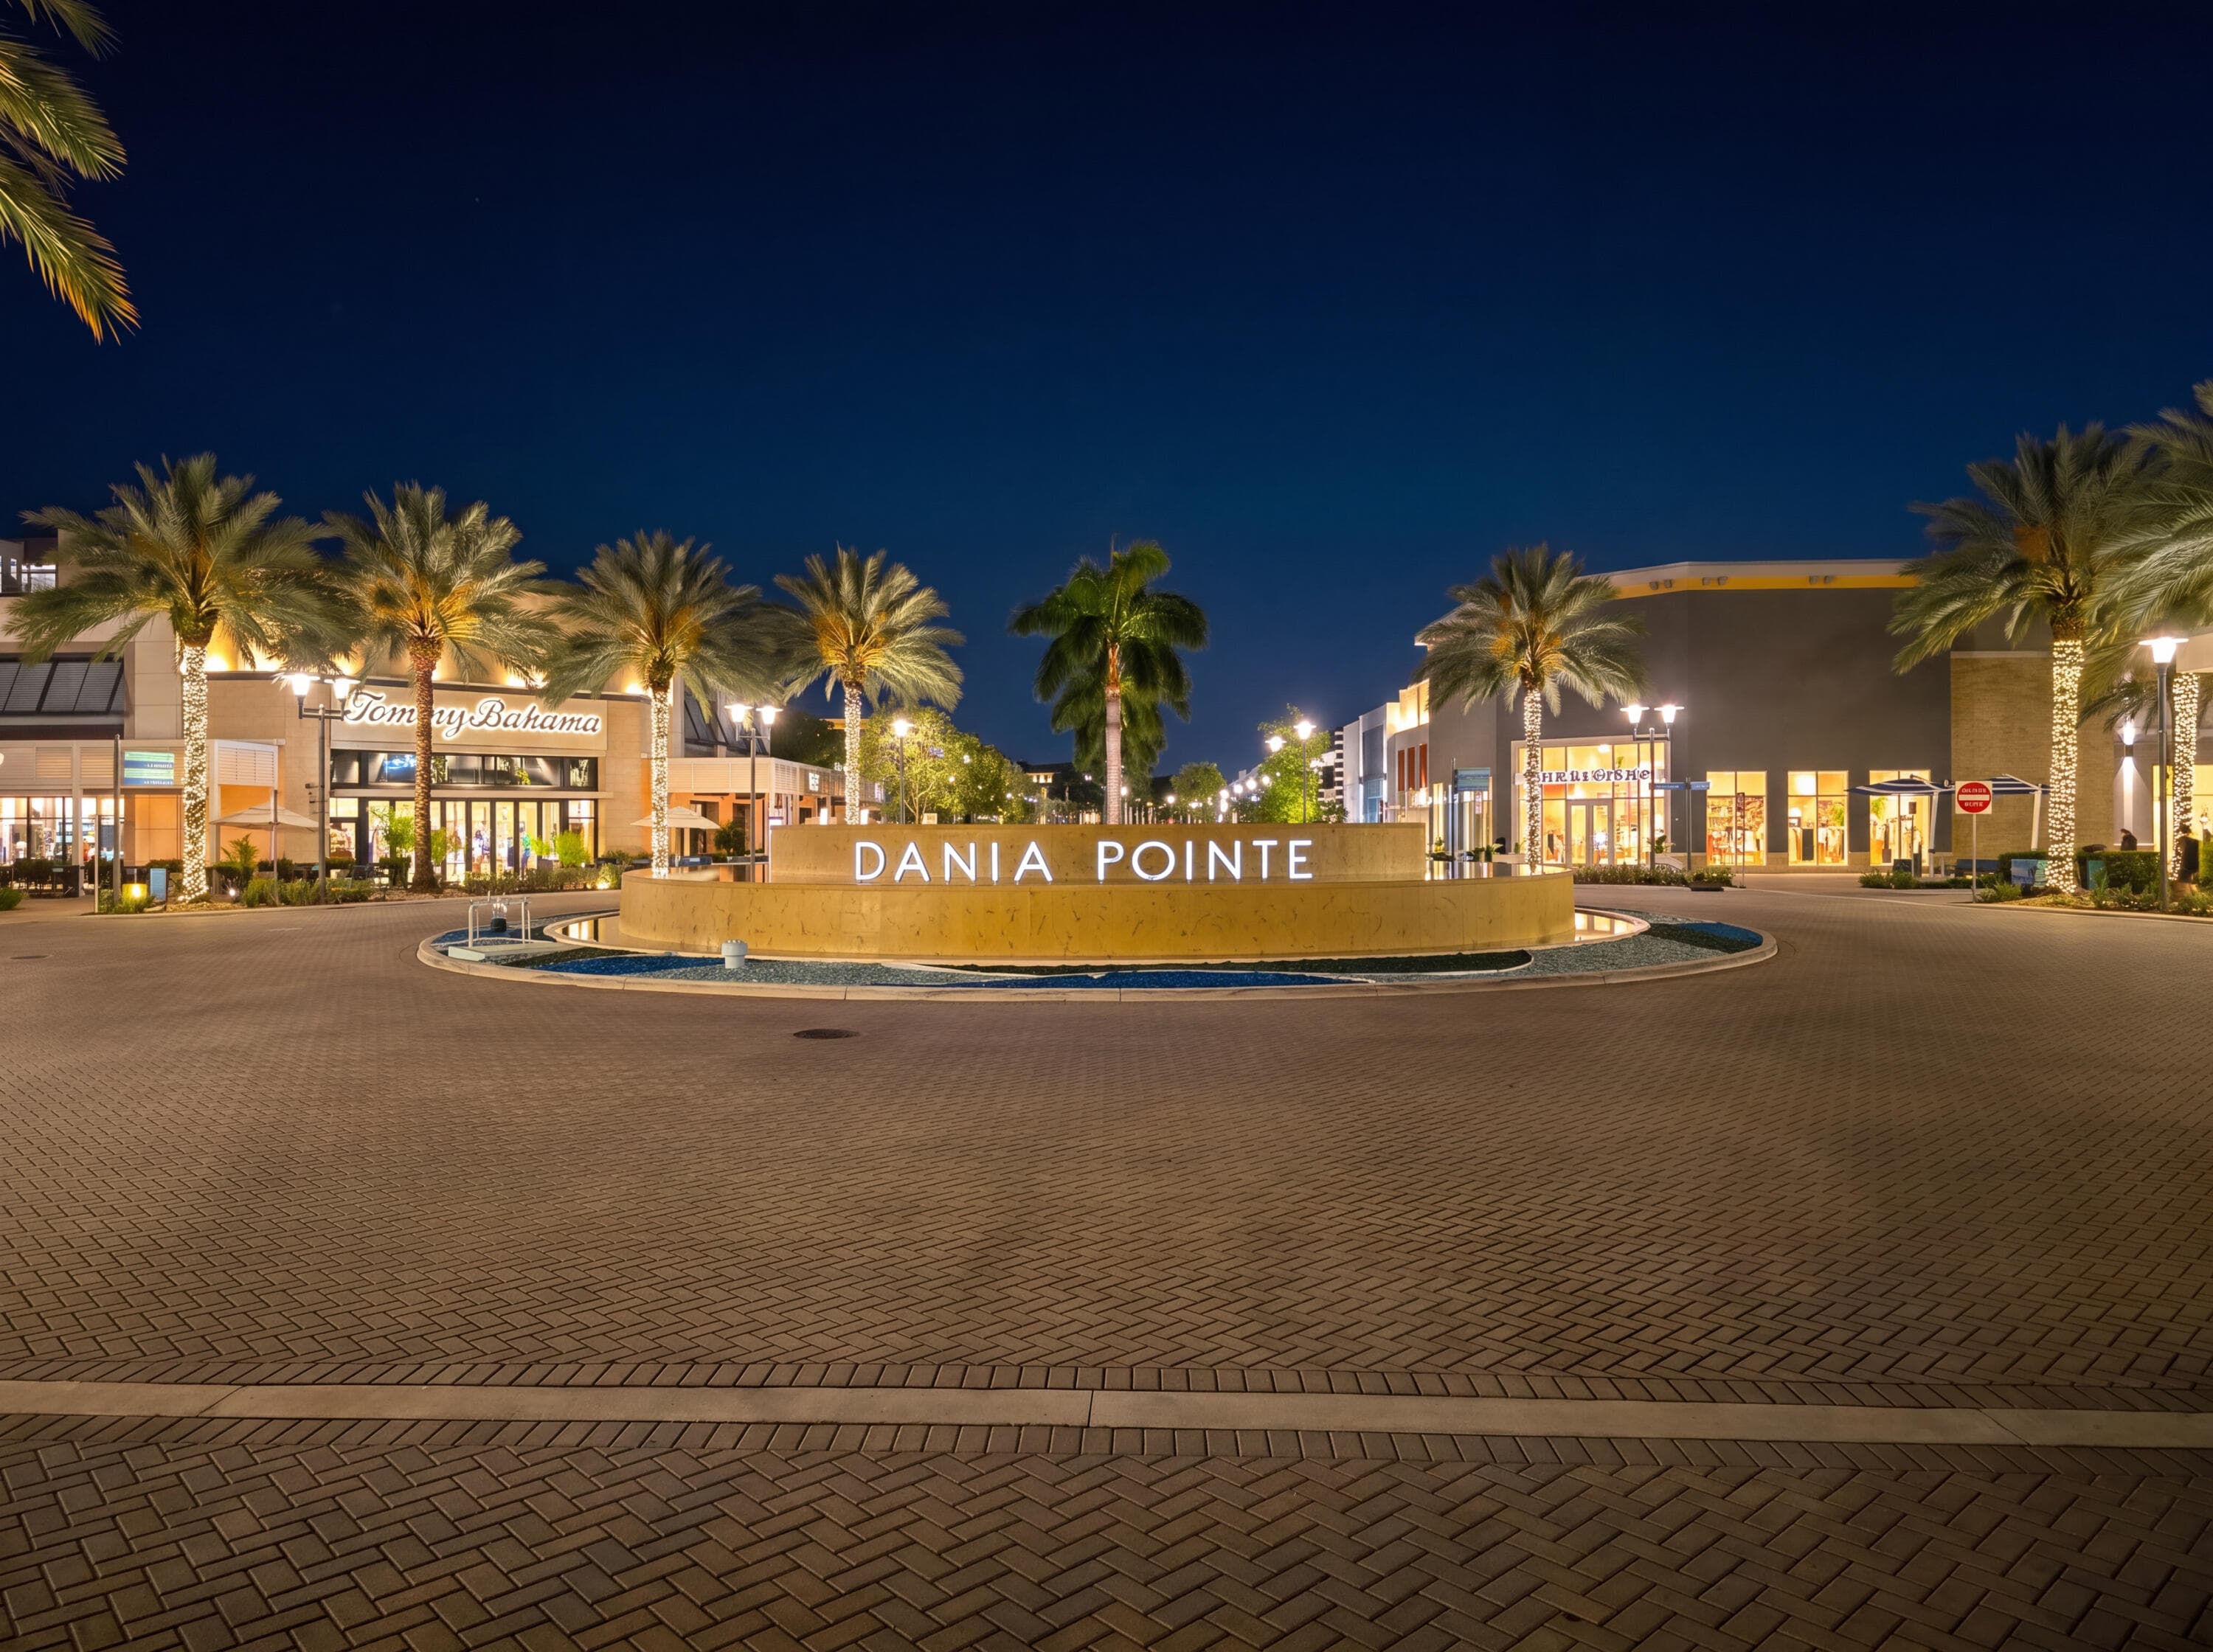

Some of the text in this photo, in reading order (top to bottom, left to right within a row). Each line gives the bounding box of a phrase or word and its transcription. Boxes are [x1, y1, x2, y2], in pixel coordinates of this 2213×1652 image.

[469, 699, 601, 733] Bahama
[854, 840, 1313, 883] DANIA POINTE
